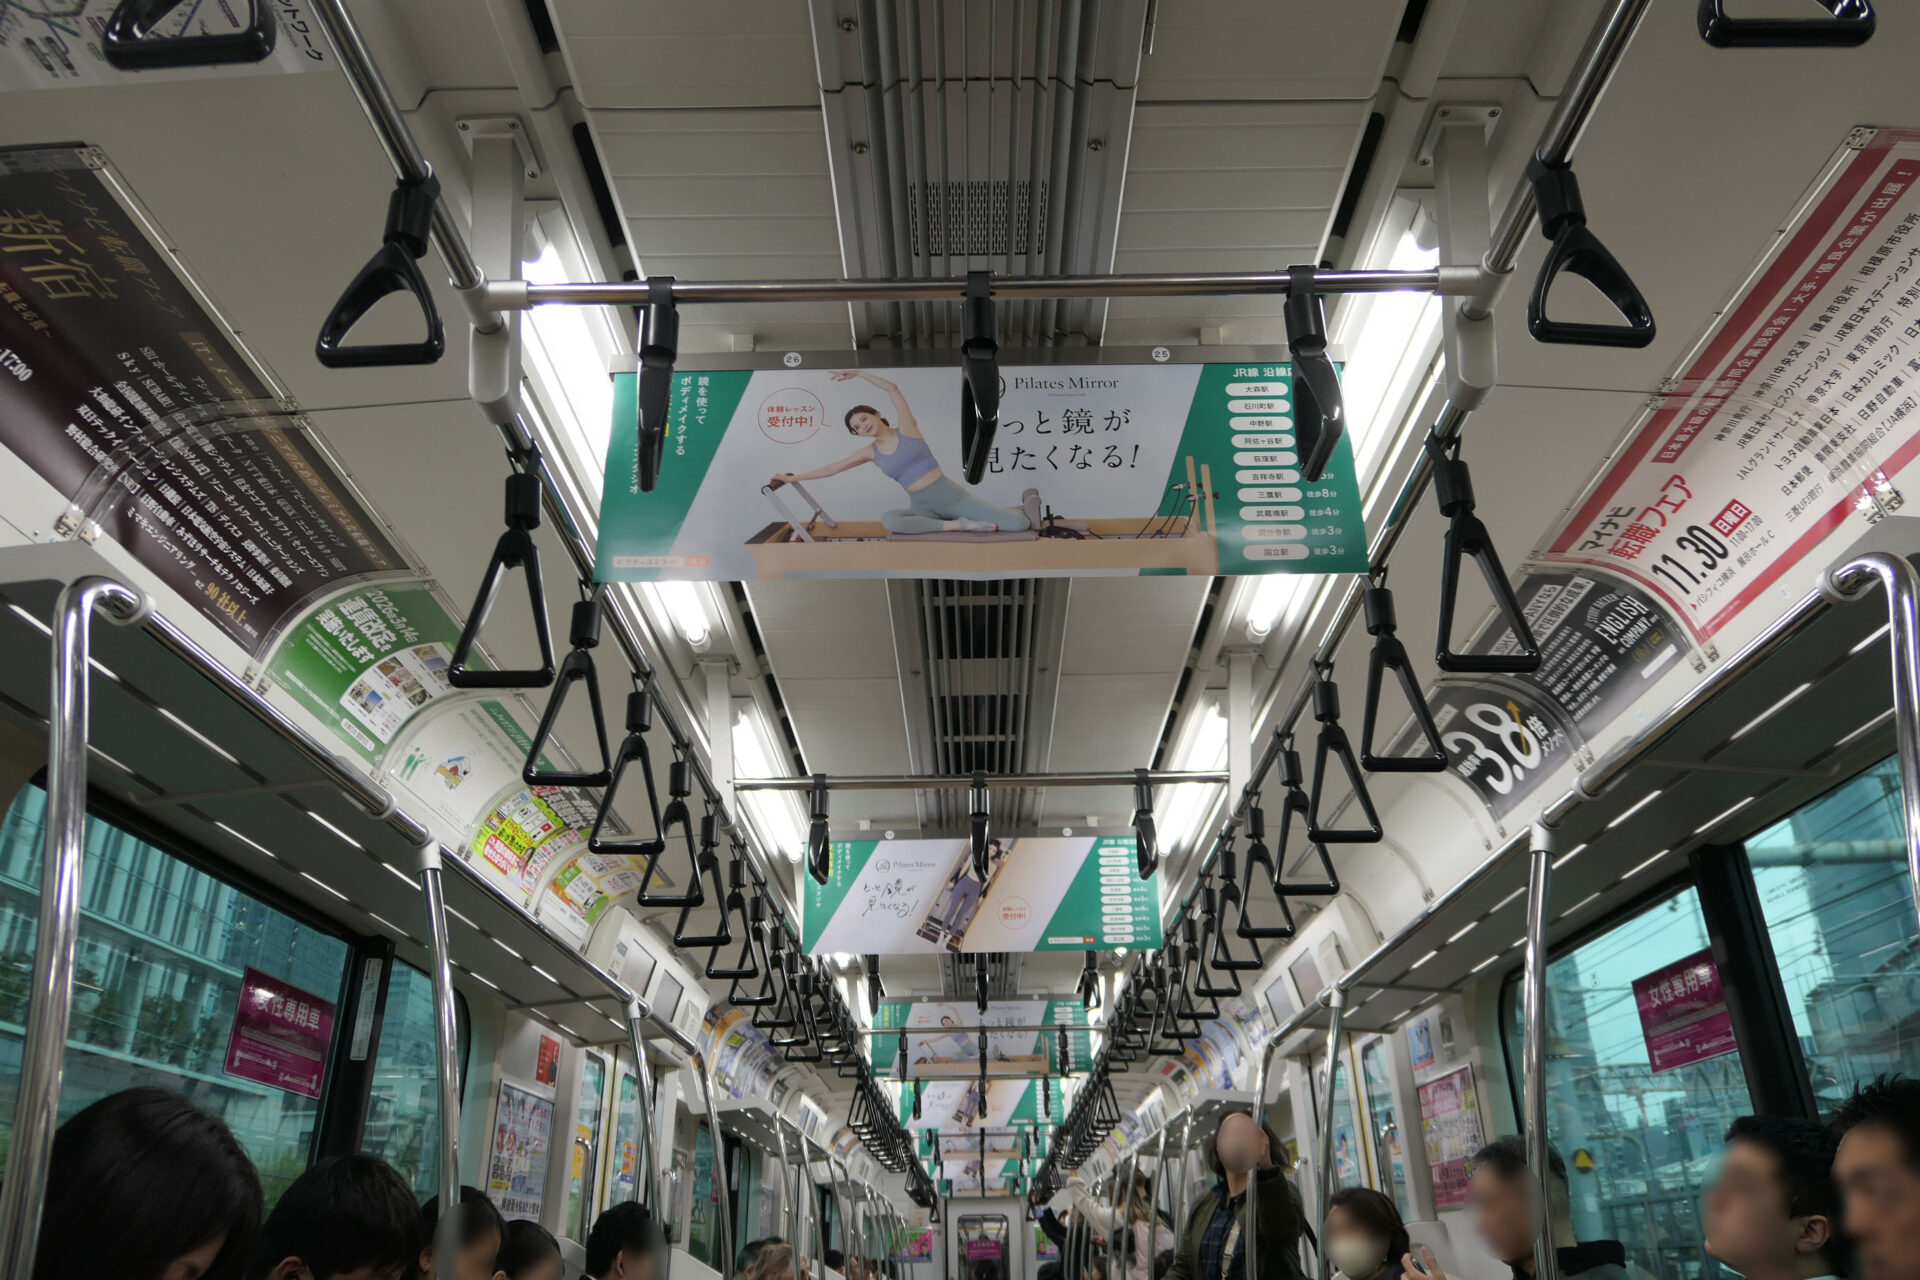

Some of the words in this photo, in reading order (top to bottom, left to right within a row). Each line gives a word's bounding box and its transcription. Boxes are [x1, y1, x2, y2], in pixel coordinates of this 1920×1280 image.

[785, 355, 800, 364] 26
[1154, 350, 1169, 359] 25
[1232, 367, 1259, 378] JR線
[695, 376, 710, 424] 鏡を使って
[1015, 376, 1064, 389] Pilates
[1068, 376, 1119, 389] Mirror
[1735, 411, 1805, 480] JALグランドサービス
[1805, 368, 1844, 404] 帝京大学
[1843, 314, 1895, 364] 東京消防庁
[1773, 404, 1841, 471] トヨタ自動車東日本
[1841, 342, 1902, 402] 日本カルミック
[675, 376, 692, 456] ボディメイクする
[767, 405, 816, 413] 体験レッスン
[767, 415, 814, 428] 受付中!
[1779, 464, 1814, 496] 日本郵便
[1856, 374, 1905, 421] 日野自動車
[1577, 504, 1636, 555] マイナビ
[1606, 473, 1695, 560] 転職フェア
[1651, 524, 1730, 597] 11.30
[1716, 504, 1748, 538] 日曜日
[314, 609, 376, 665] 実施いたします
[1594, 593, 1650, 645] ENGLISH
[1619, 617, 1652, 648] COMPANY
[1648, 963, 1713, 1008] 女性専用車
